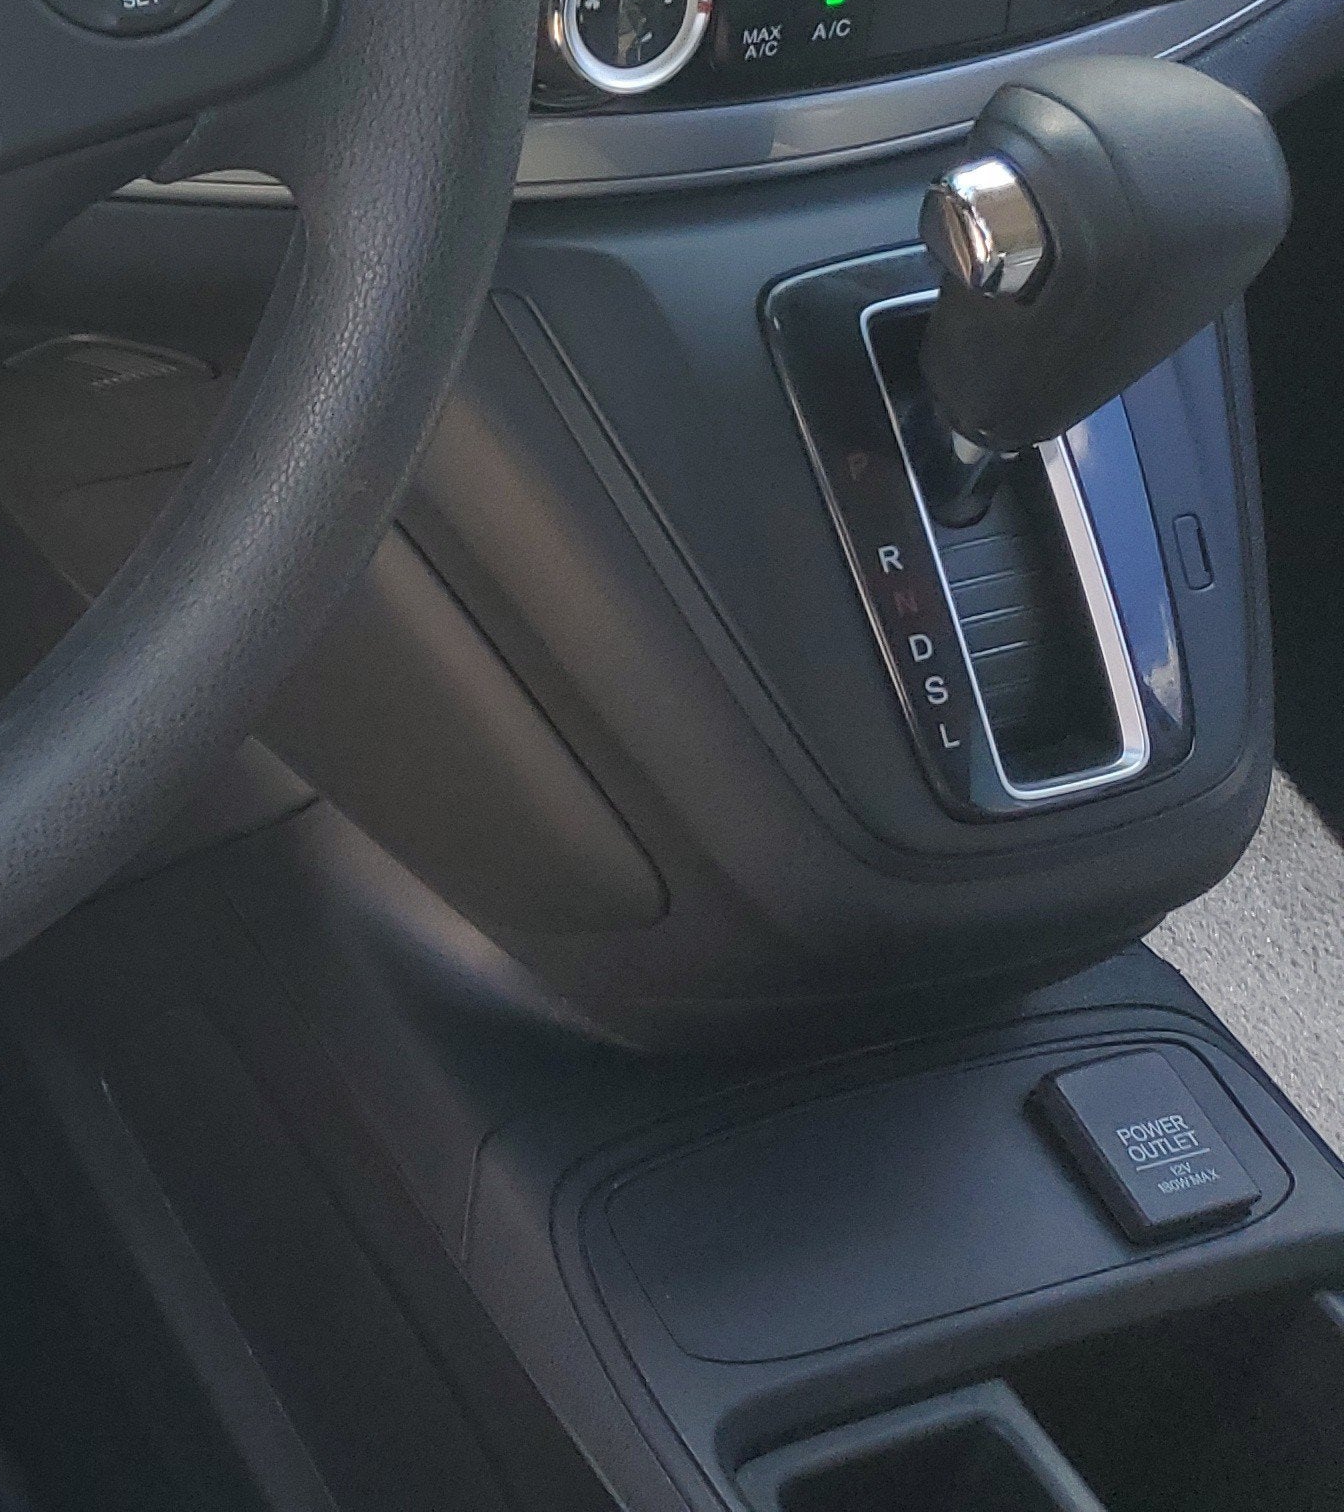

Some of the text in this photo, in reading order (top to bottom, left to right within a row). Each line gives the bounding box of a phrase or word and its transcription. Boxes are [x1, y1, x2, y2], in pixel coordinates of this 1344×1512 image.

[742, 24, 782, 45] MAX
[812, 18, 851, 40] A/C
[744, 42, 778, 61] A/C
[877, 545, 904, 574] R
[908, 634, 932, 662] D
[925, 676, 949, 705] S
[939, 723, 960, 749] L
[1116, 1114, 1189, 1145] POWER
[1127, 1131, 1200, 1163] OUTLET
